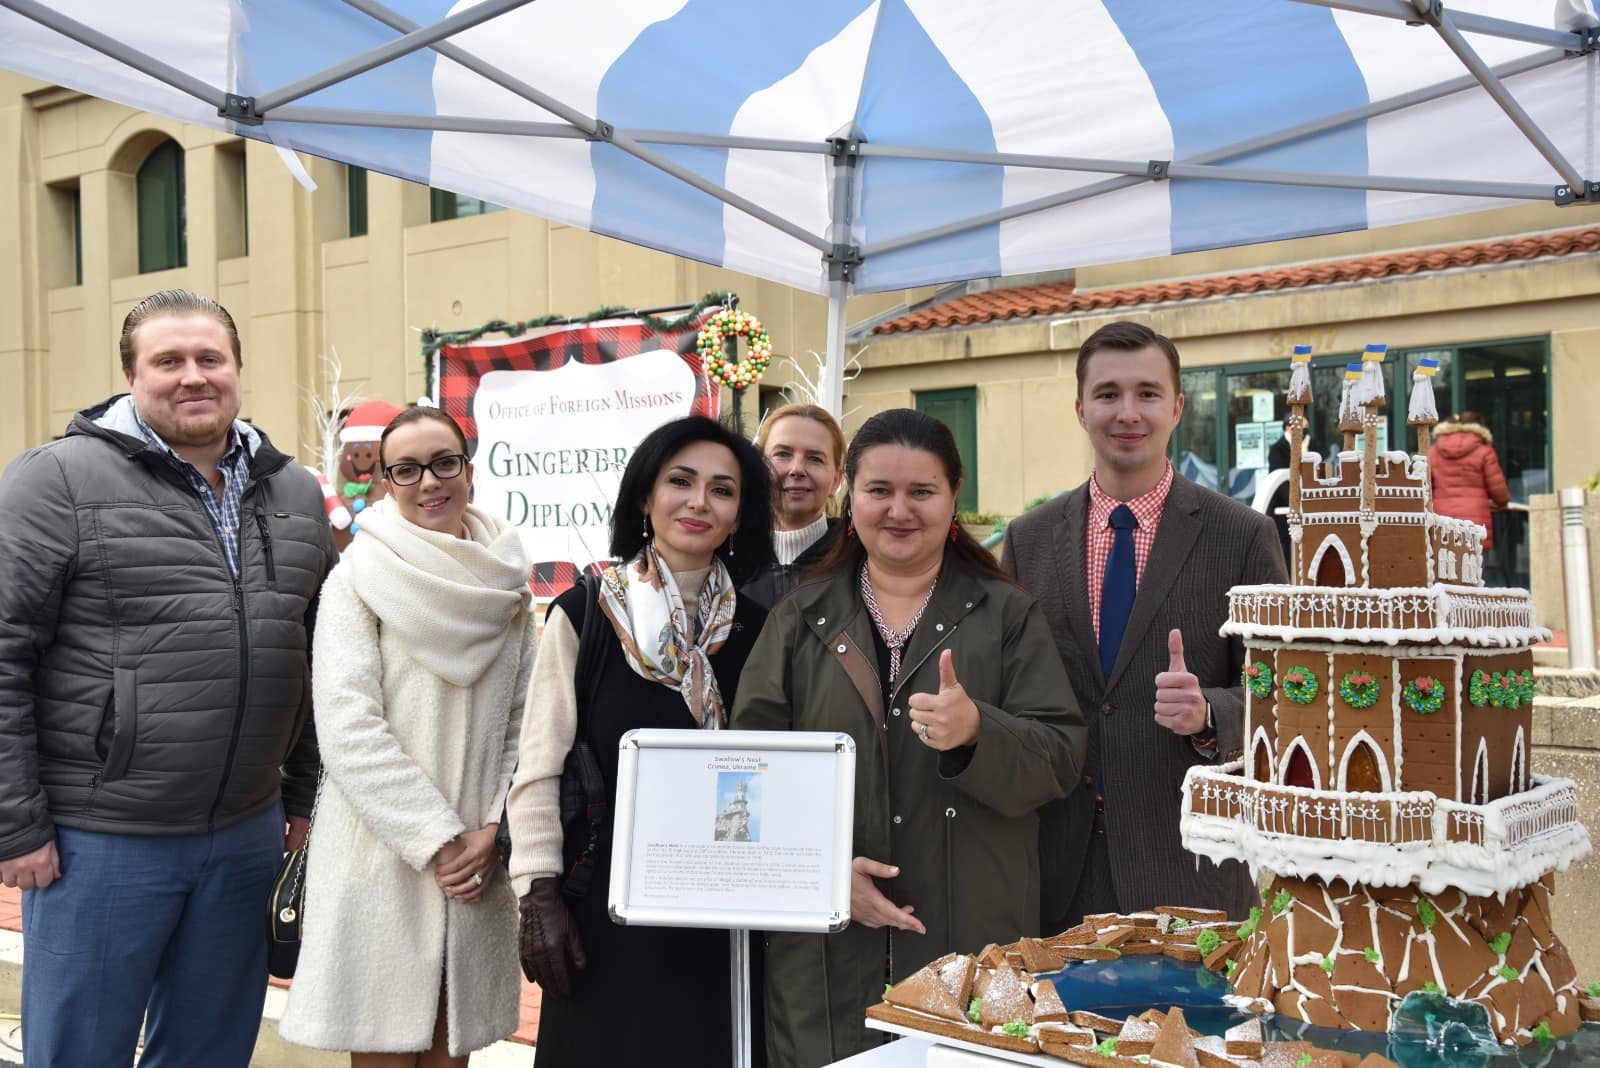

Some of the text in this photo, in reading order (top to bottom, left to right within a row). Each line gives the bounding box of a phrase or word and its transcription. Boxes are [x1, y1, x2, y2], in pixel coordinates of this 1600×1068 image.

[489, 390, 683, 420] OFFICE OF FOREIGN MISSIONS
[488, 441, 637, 478] GINGERBR
